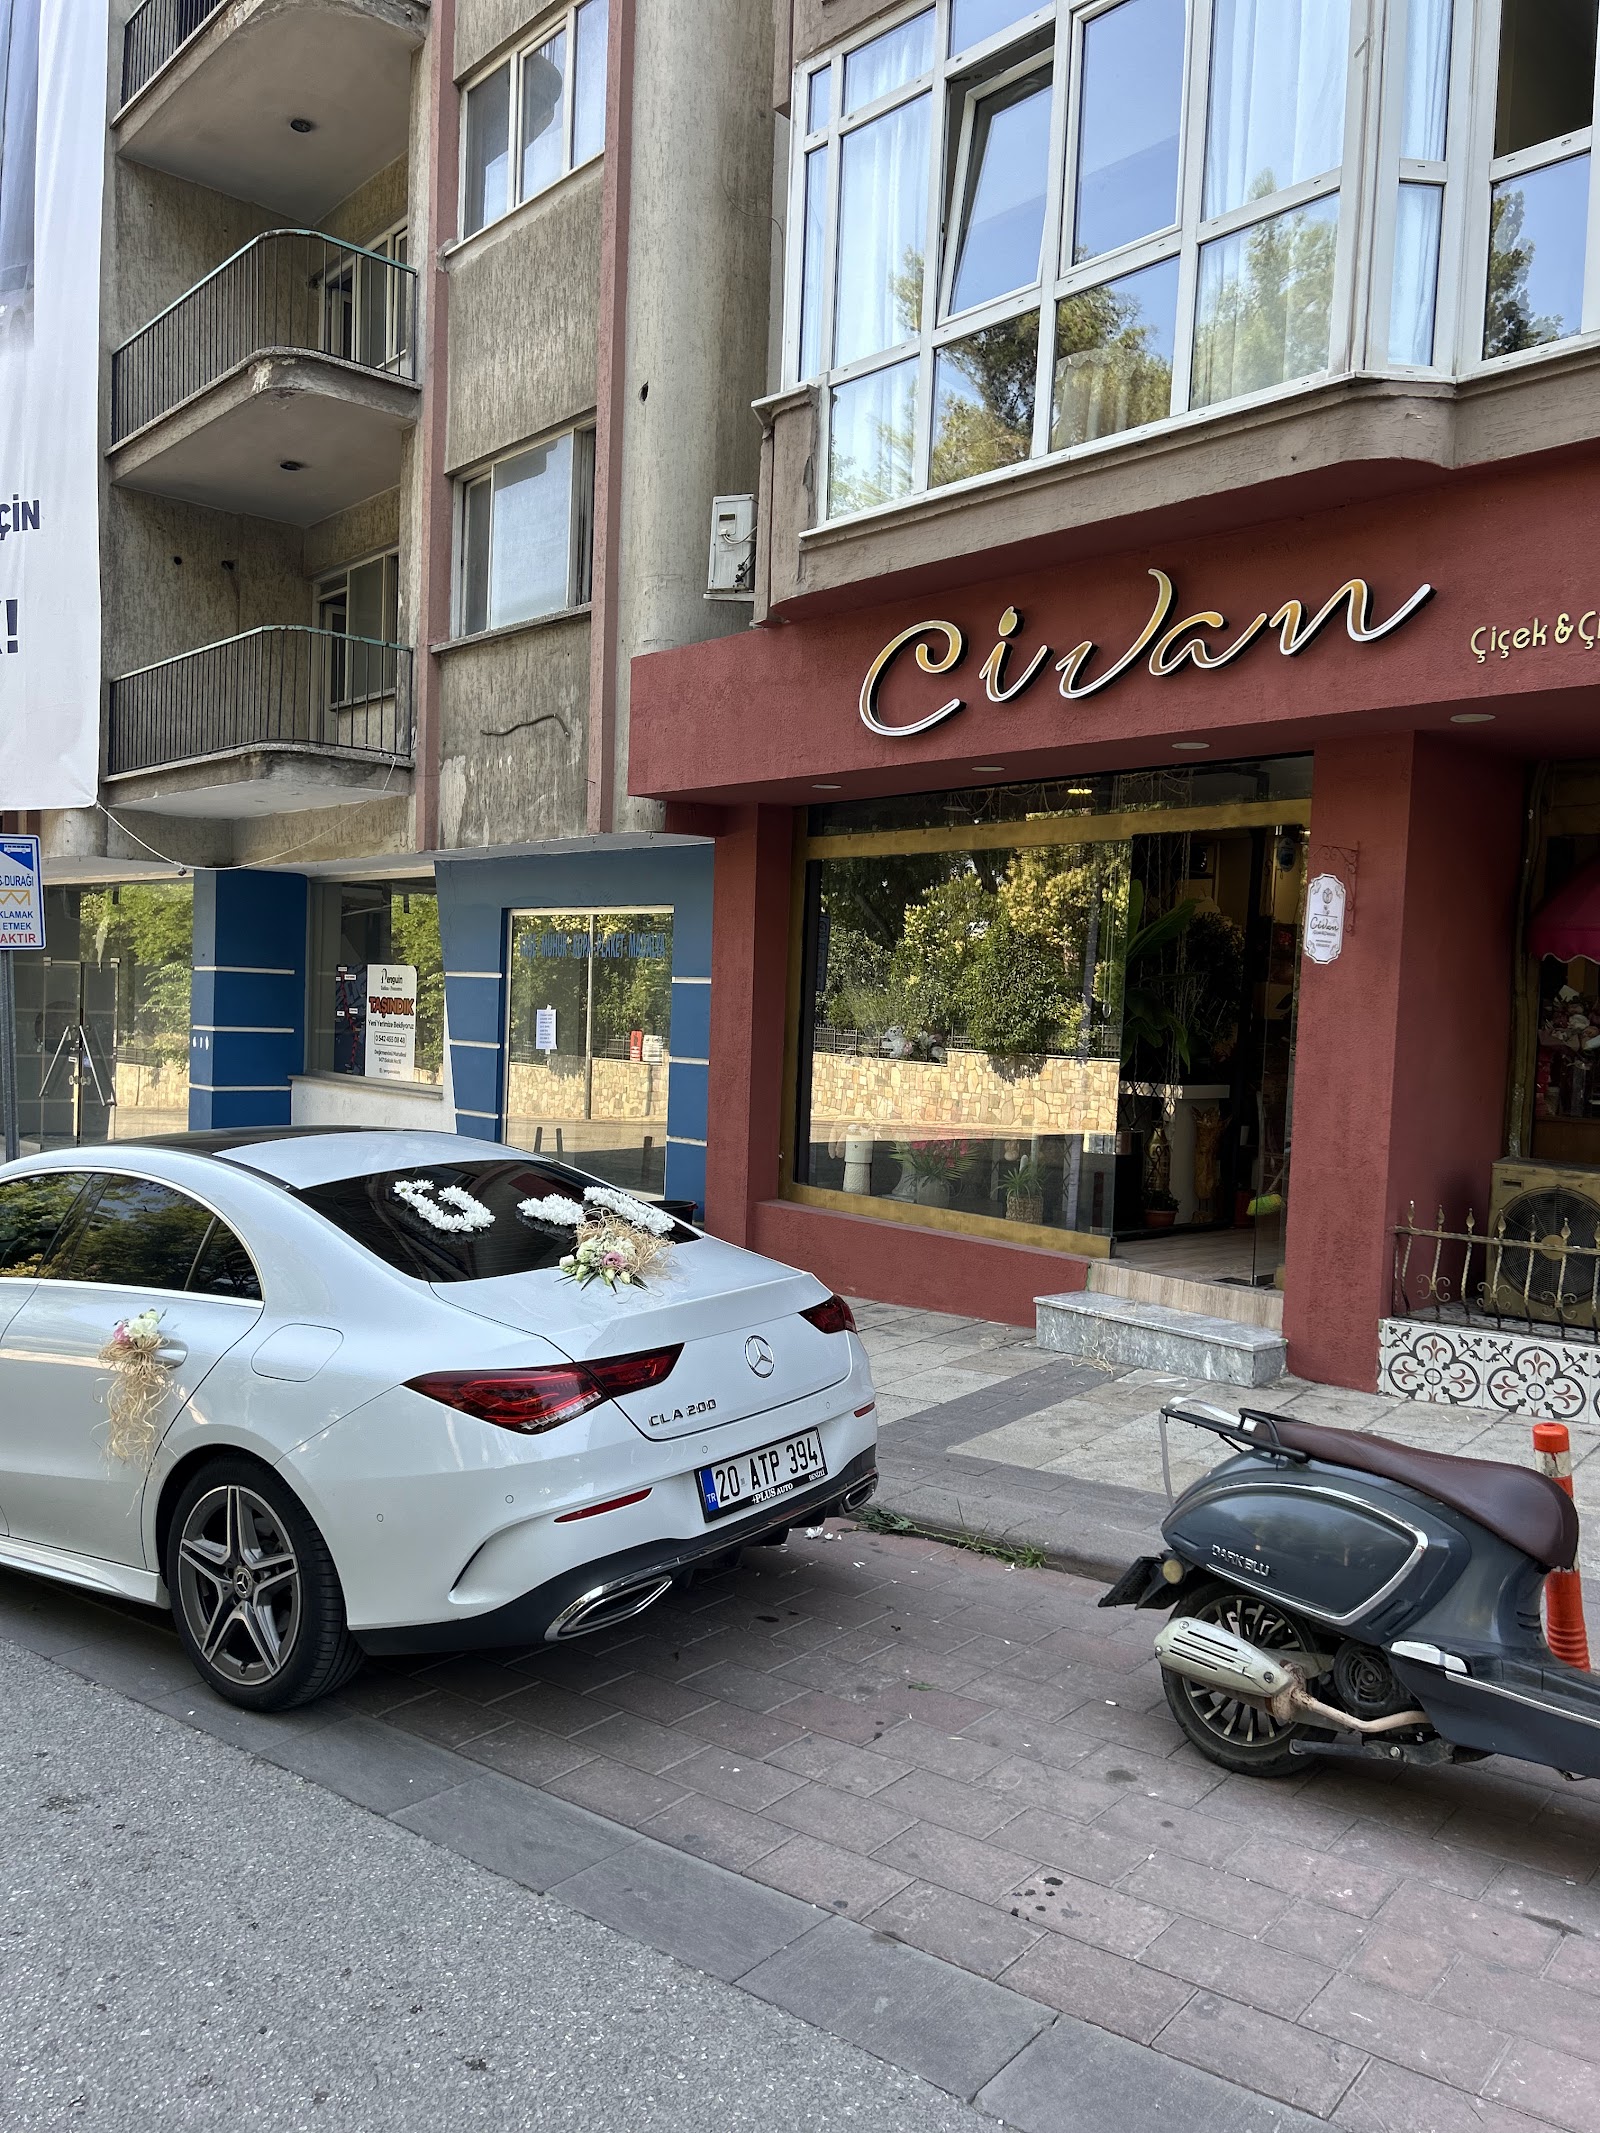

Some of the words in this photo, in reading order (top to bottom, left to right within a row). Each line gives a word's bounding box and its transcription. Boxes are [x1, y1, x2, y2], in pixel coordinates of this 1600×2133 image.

[1470, 617, 1548, 664] Çiçek
[1554, 612, 1574, 644] &
[4, 873, 34, 887] DURAĞI
[2, 922, 32, 931] ETMEK
[0, 933, 36, 944] AKTIR
[368, 996, 415, 1018] TAŞINDIK
[648, 1409, 684, 1427] CLA
[686, 1399, 717, 1417] 200
[715, 1466, 741, 1502] 20
[749, 1450, 780, 1490] ATP
[786, 1437, 818, 1474] 394
[776, 1482, 794, 1496] AUTO
[706, 1492, 717, 1504] TR
